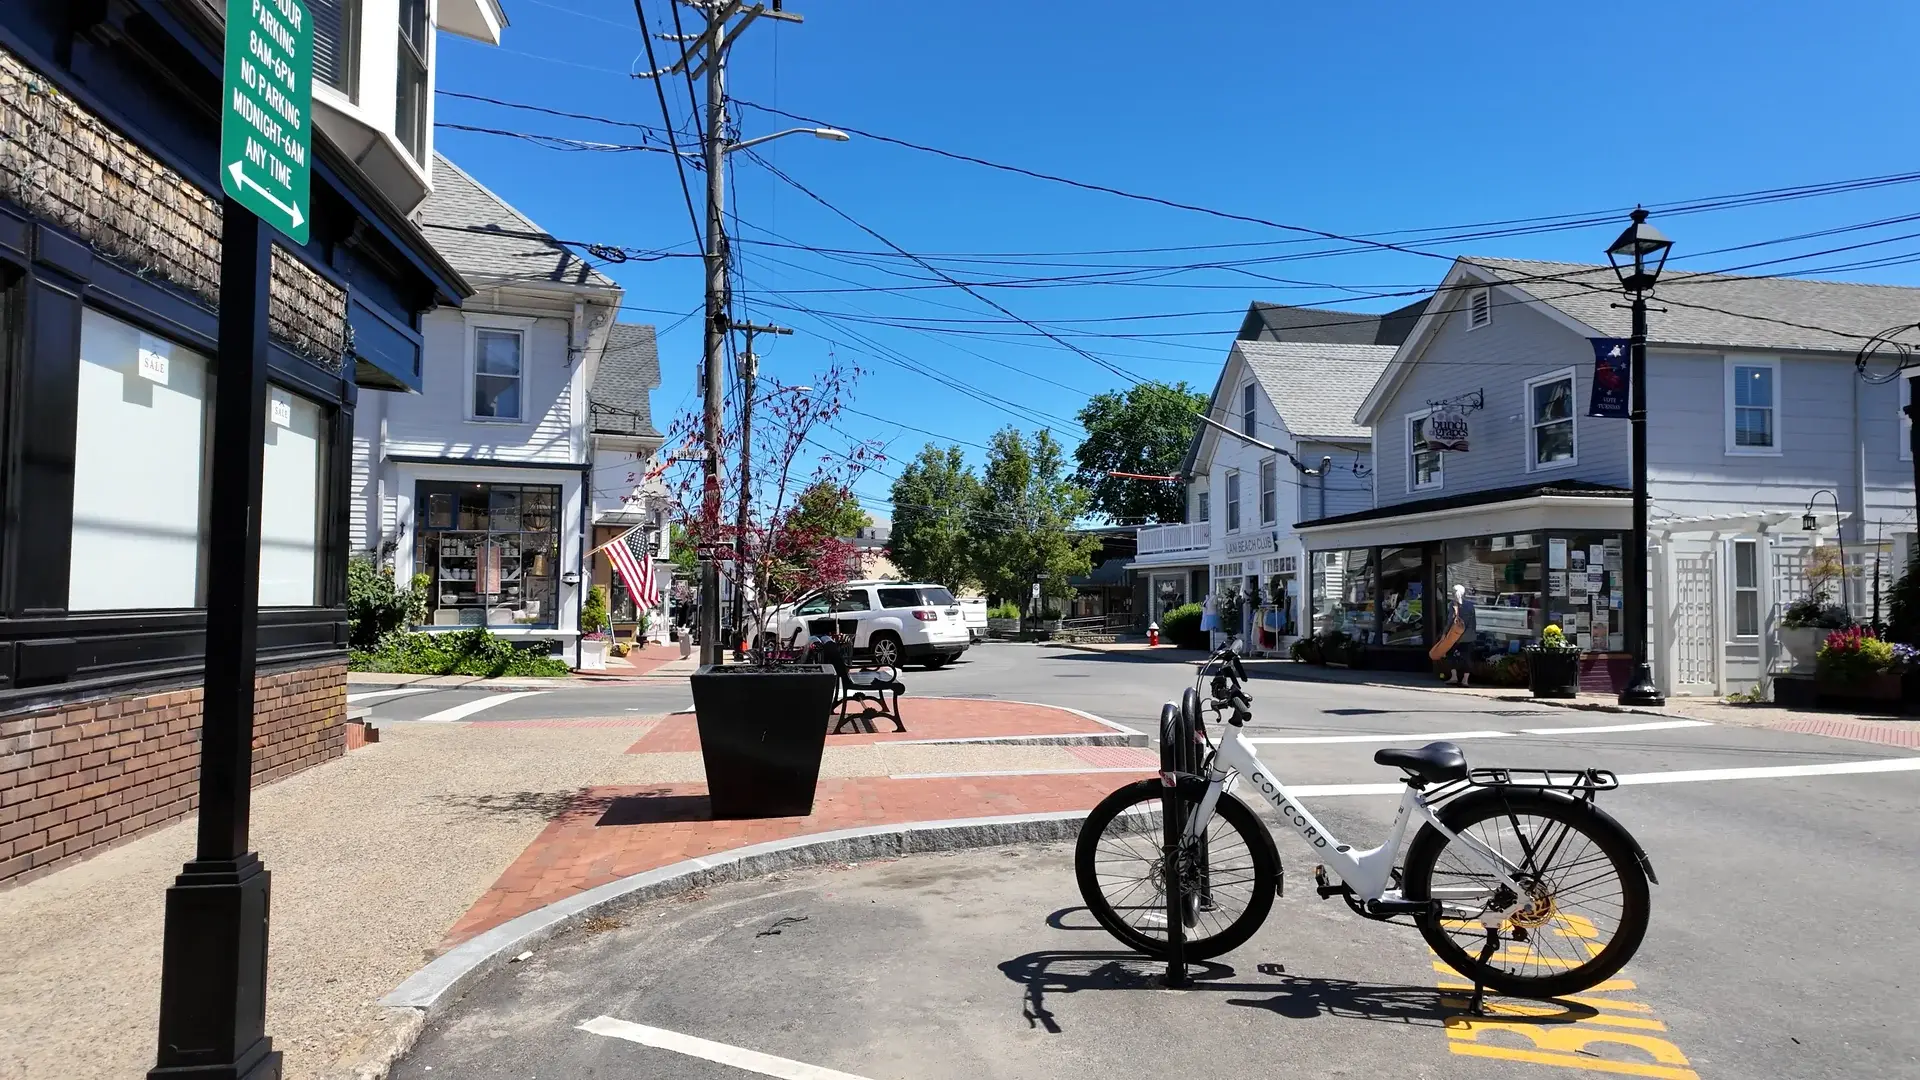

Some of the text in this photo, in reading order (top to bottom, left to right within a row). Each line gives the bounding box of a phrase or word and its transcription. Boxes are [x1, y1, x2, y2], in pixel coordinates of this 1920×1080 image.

[252, 0, 295, 58] PARKING
[250, 30, 295, 92] 8AM-6PM
[241, 57, 300, 130] NO PARKING
[233, 87, 305, 168] MIDNIGHT-6AM
[245, 136, 292, 190] ANY TIME
[144, 357, 165, 374] SALE
[274, 406, 288, 419] SALE
[1432, 417, 1468, 431] bunch
[1238, 539, 1256, 553] BEACH
[1257, 536, 1272, 550] CLUB
[1252, 772, 1327, 849] CONCORD
